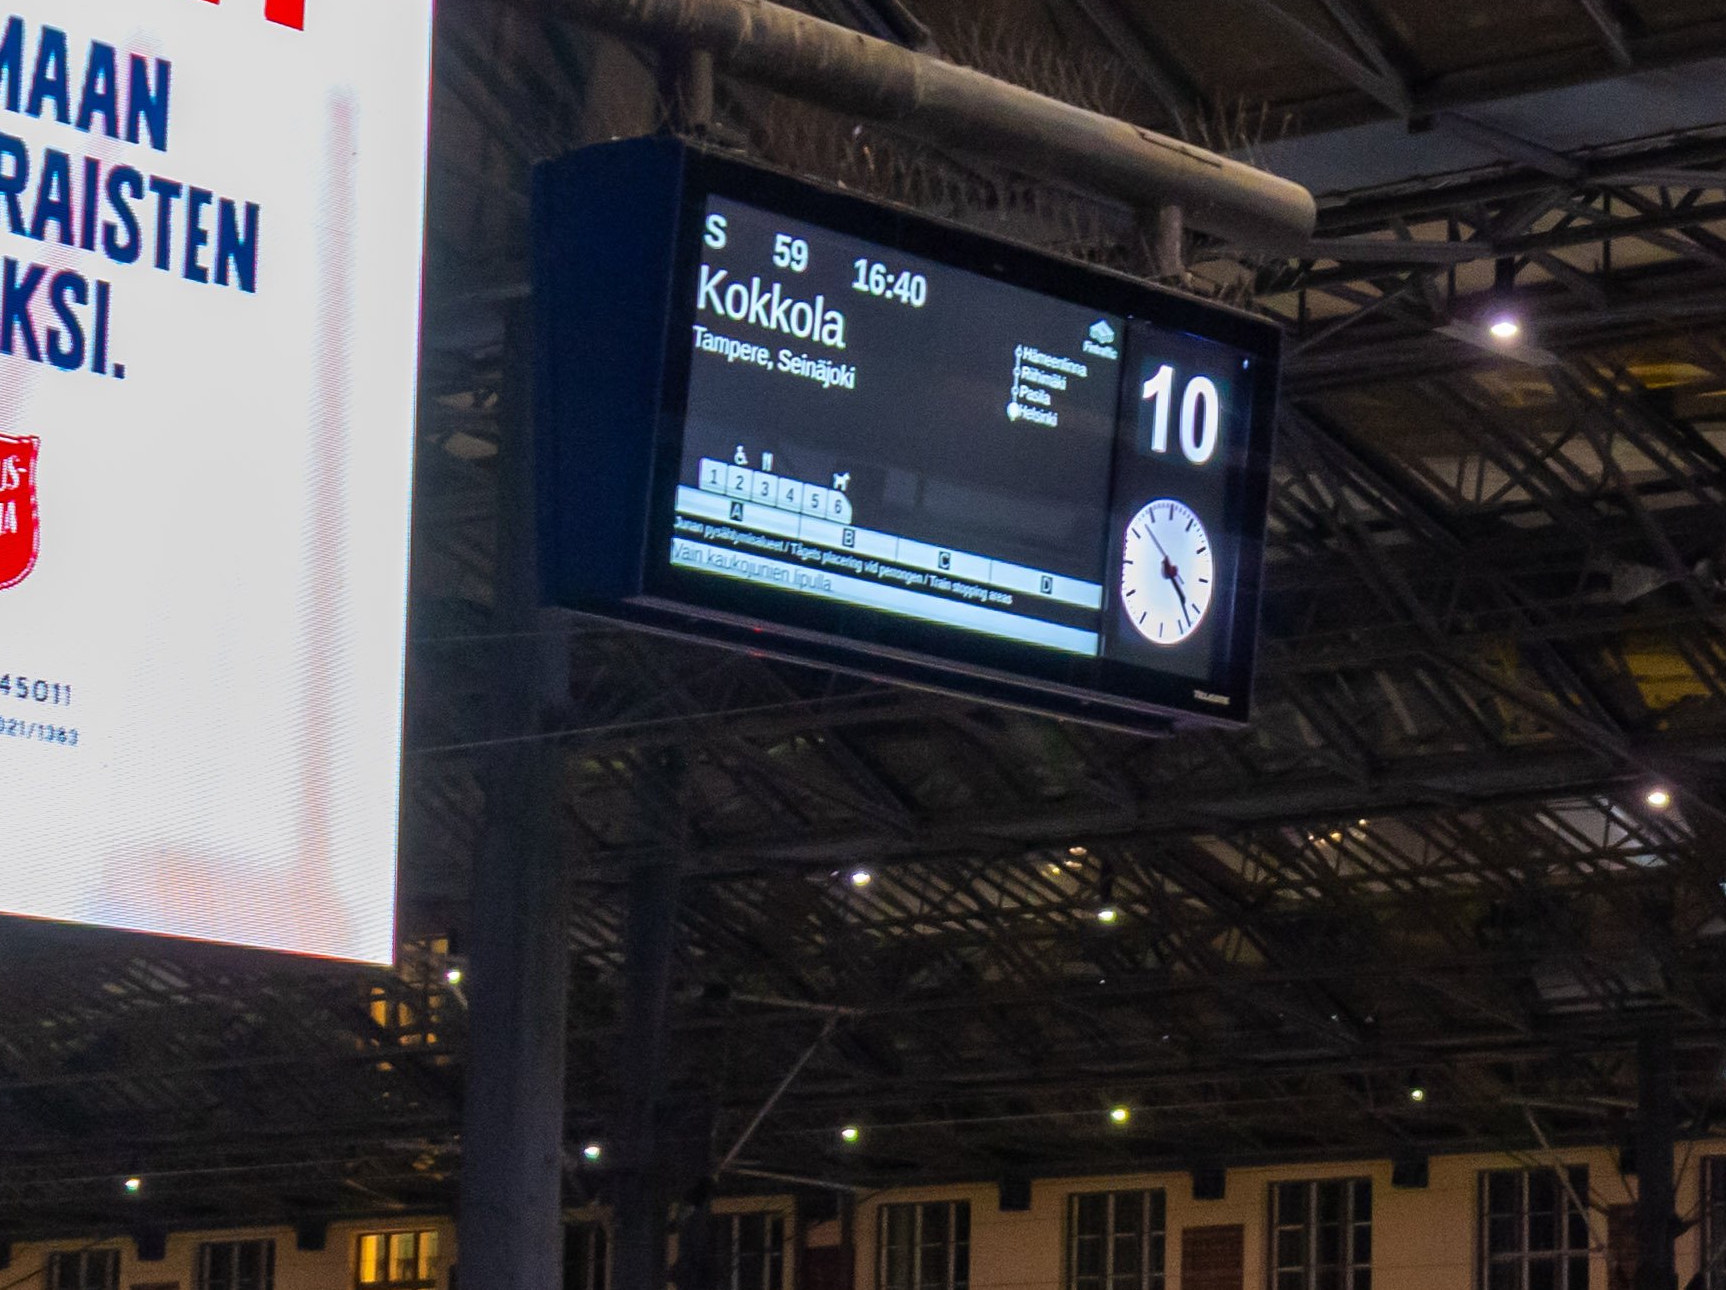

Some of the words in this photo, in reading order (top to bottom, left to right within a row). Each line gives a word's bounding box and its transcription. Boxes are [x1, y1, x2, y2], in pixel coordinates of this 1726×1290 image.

[704, 213, 727, 249] S
[773, 232, 808, 272] 59
[852, 258, 927, 308] 16:40
[696, 264, 846, 350] Kokkola
[692, 325, 774, 370] Tampere,
[778, 349, 856, 389] Seinäjoki
[1018, 403, 1058, 427] Helsinki
[1019, 384, 1051, 406] Pasila
[1142, 364, 1218, 464] 10
[710, 469, 718, 485] 1
[735, 475, 744, 490] 2
[761, 481, 770, 497] 3
[786, 488, 794, 503] 4
[811, 494, 819, 509] 5
[834, 499, 843, 514] 6
[674, 543, 703, 561] Vain
[708, 548, 789, 583] kaukojunien
[730, 503, 743, 519] A
[844, 530, 855, 547] B
[939, 552, 950, 569] C
[1041, 577, 1052, 594] D
[930, 575, 951, 592] Train
[952, 581, 988, 602] stopping
